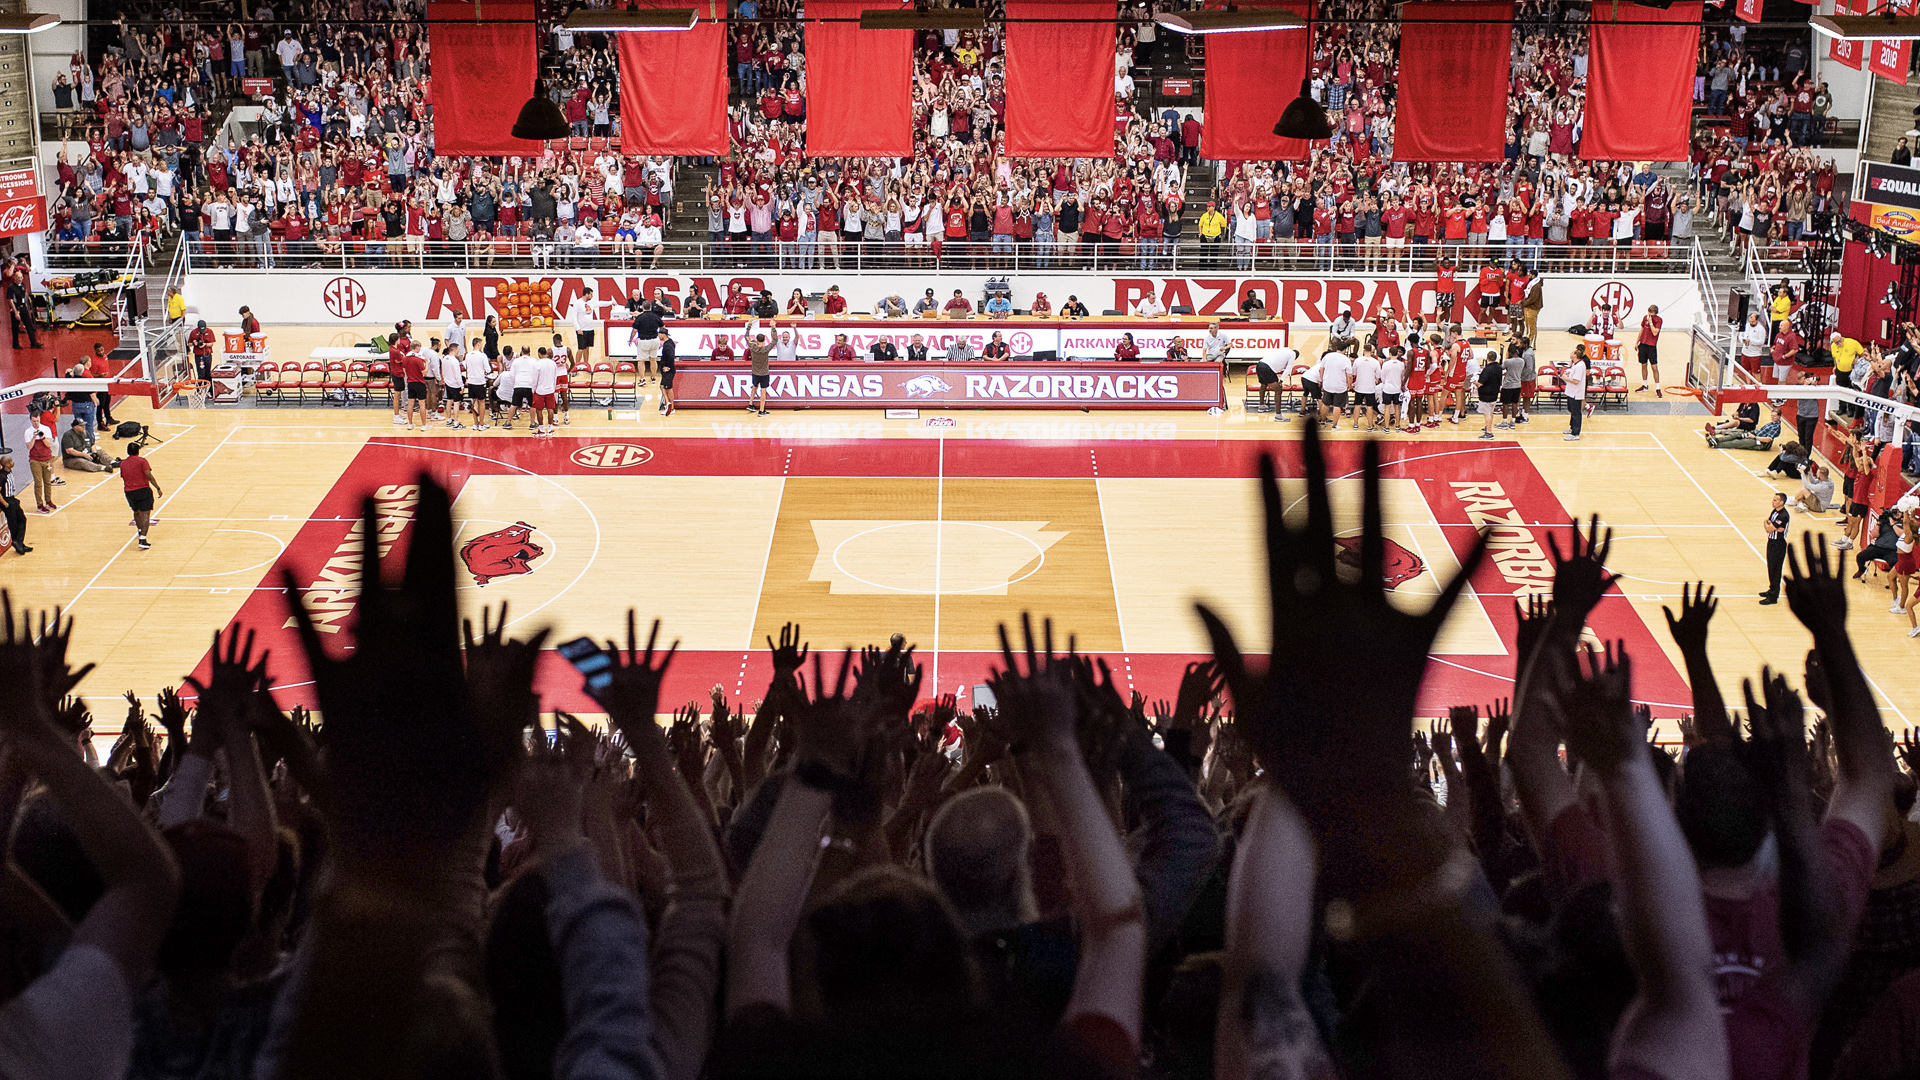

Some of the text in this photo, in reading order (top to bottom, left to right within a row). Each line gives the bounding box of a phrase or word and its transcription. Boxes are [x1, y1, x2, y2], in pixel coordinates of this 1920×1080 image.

[1880, 46, 1898, 69] 2018
[324, 277, 367, 319] SEC
[698, 334, 822, 350] ARKNAS
[1064, 338, 1281, 349] ARKANSRAZORBKS.COM
[553, 354, 567, 365] 23
[1416, 356, 1426, 368] 15
[709, 374, 1180, 399] ARKANSAS RAZORBACKS
[1855, 396, 1895, 413] GARED
[569, 443, 655, 469] SEC
